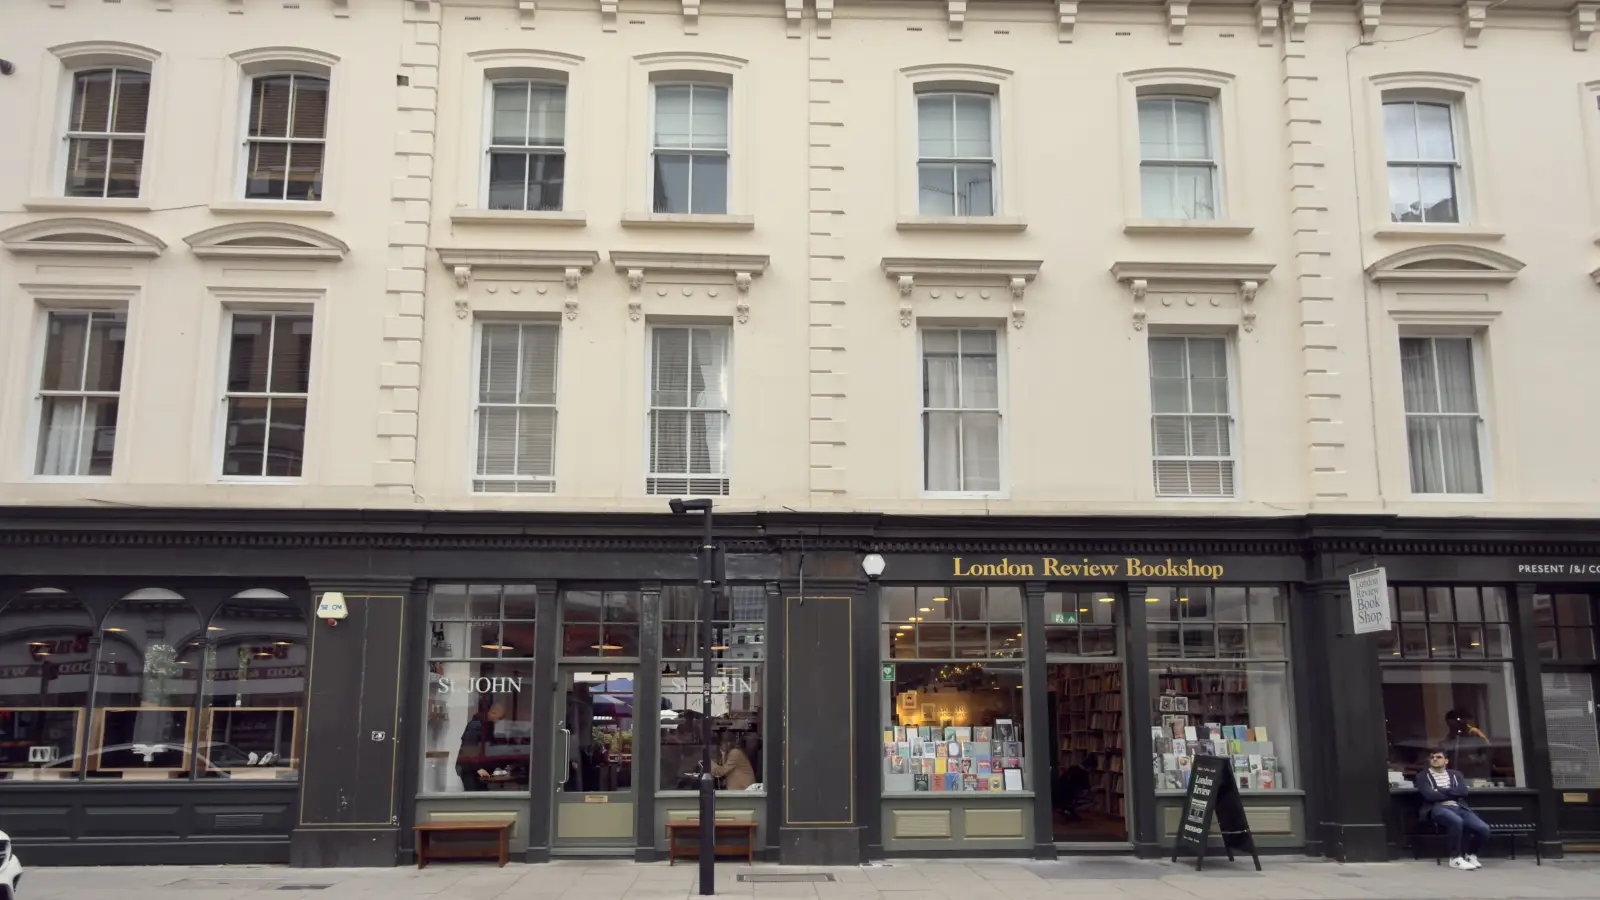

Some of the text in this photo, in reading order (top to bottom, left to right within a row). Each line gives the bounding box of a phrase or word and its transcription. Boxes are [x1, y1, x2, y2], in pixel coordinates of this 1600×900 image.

[953, 557, 1224, 580] London Review Bookshop
[1518, 564, 1564, 573] PRESENT
[1356, 577, 1378, 588] London
[1357, 587, 1379, 598] Review
[1358, 595, 1380, 610] Book
[1358, 611, 1382, 624] Shop
[467, 677, 523, 693] JOHN
[1195, 775, 1213, 786] London
[1193, 784, 1211, 796] Review
